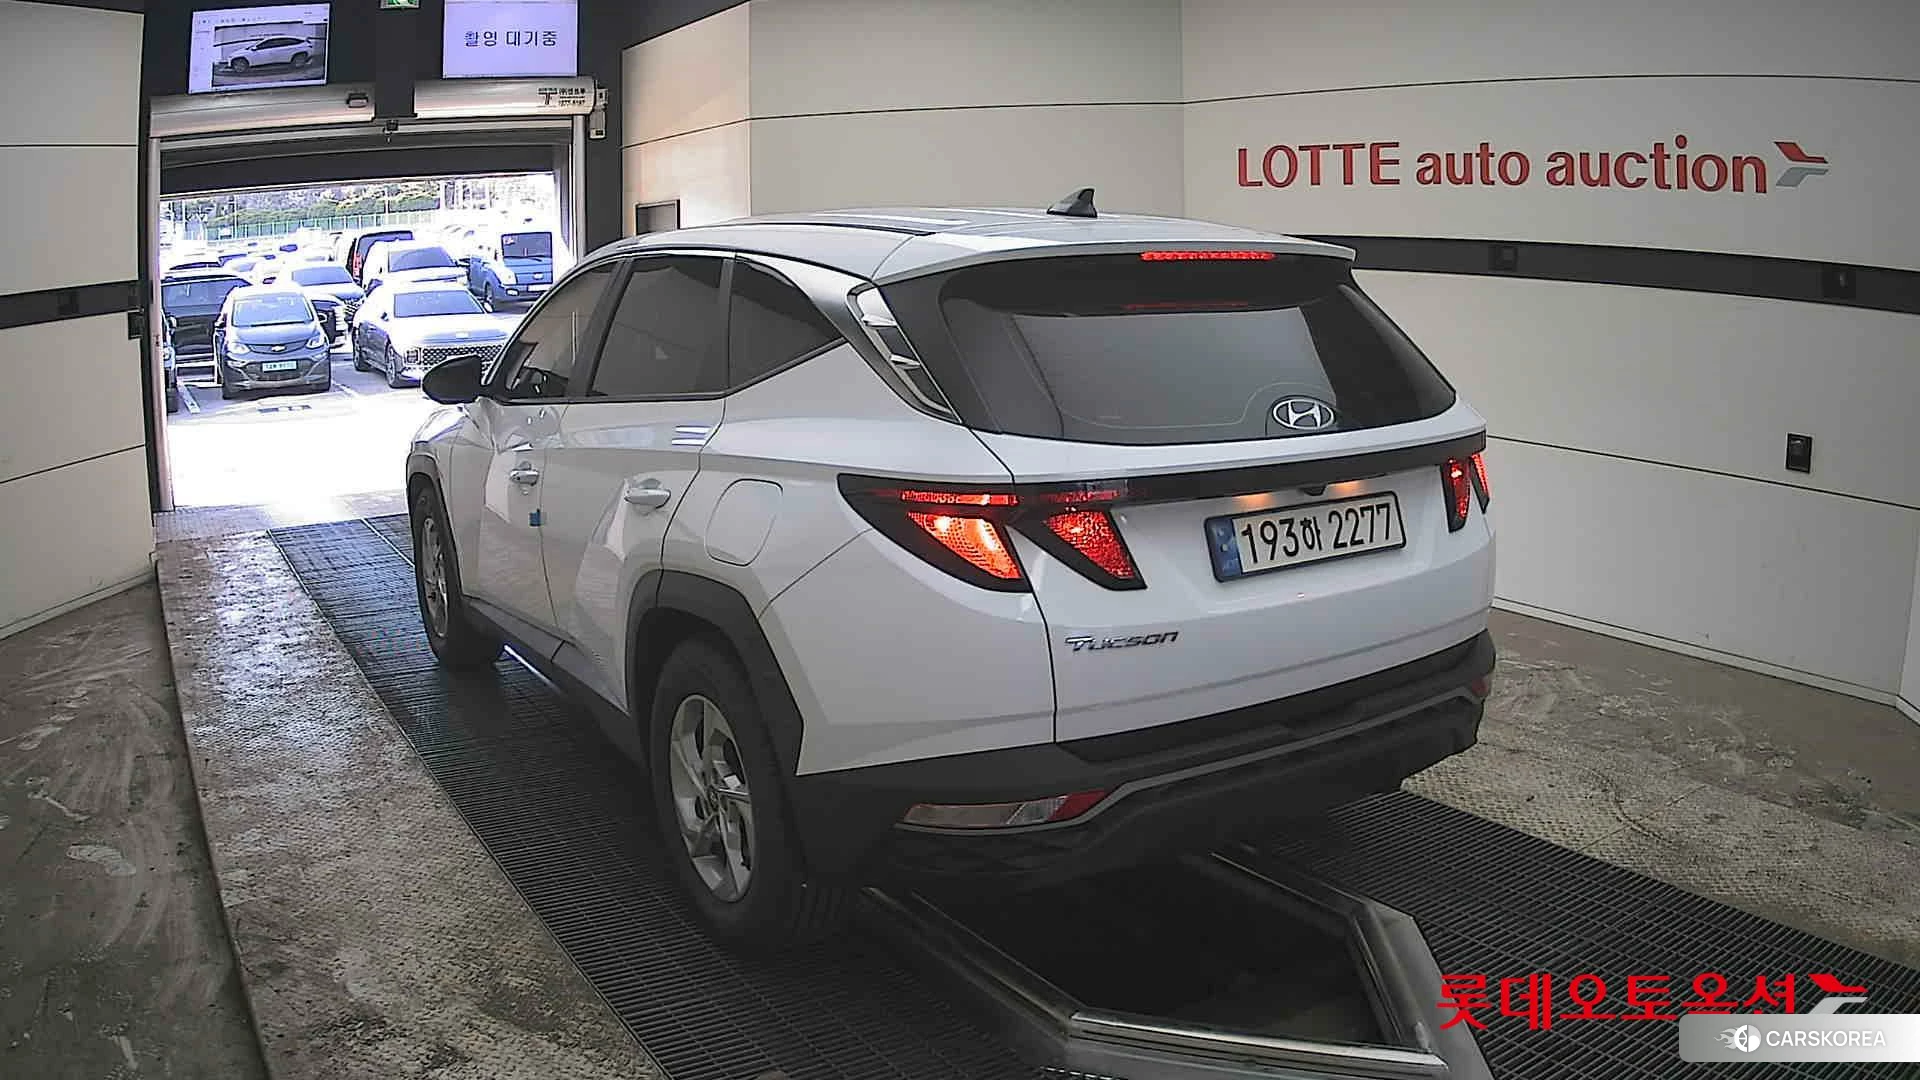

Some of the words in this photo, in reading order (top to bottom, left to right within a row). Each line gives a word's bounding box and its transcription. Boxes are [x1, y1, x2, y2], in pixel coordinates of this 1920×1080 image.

[505, 30, 558, 47] 대기중
[1237, 141, 1401, 188] LOTTE
[1415, 142, 1531, 186] auto
[1546, 134, 1767, 194] auction
[1241, 516, 1323, 564] 193하
[1328, 503, 1391, 549] 2277
